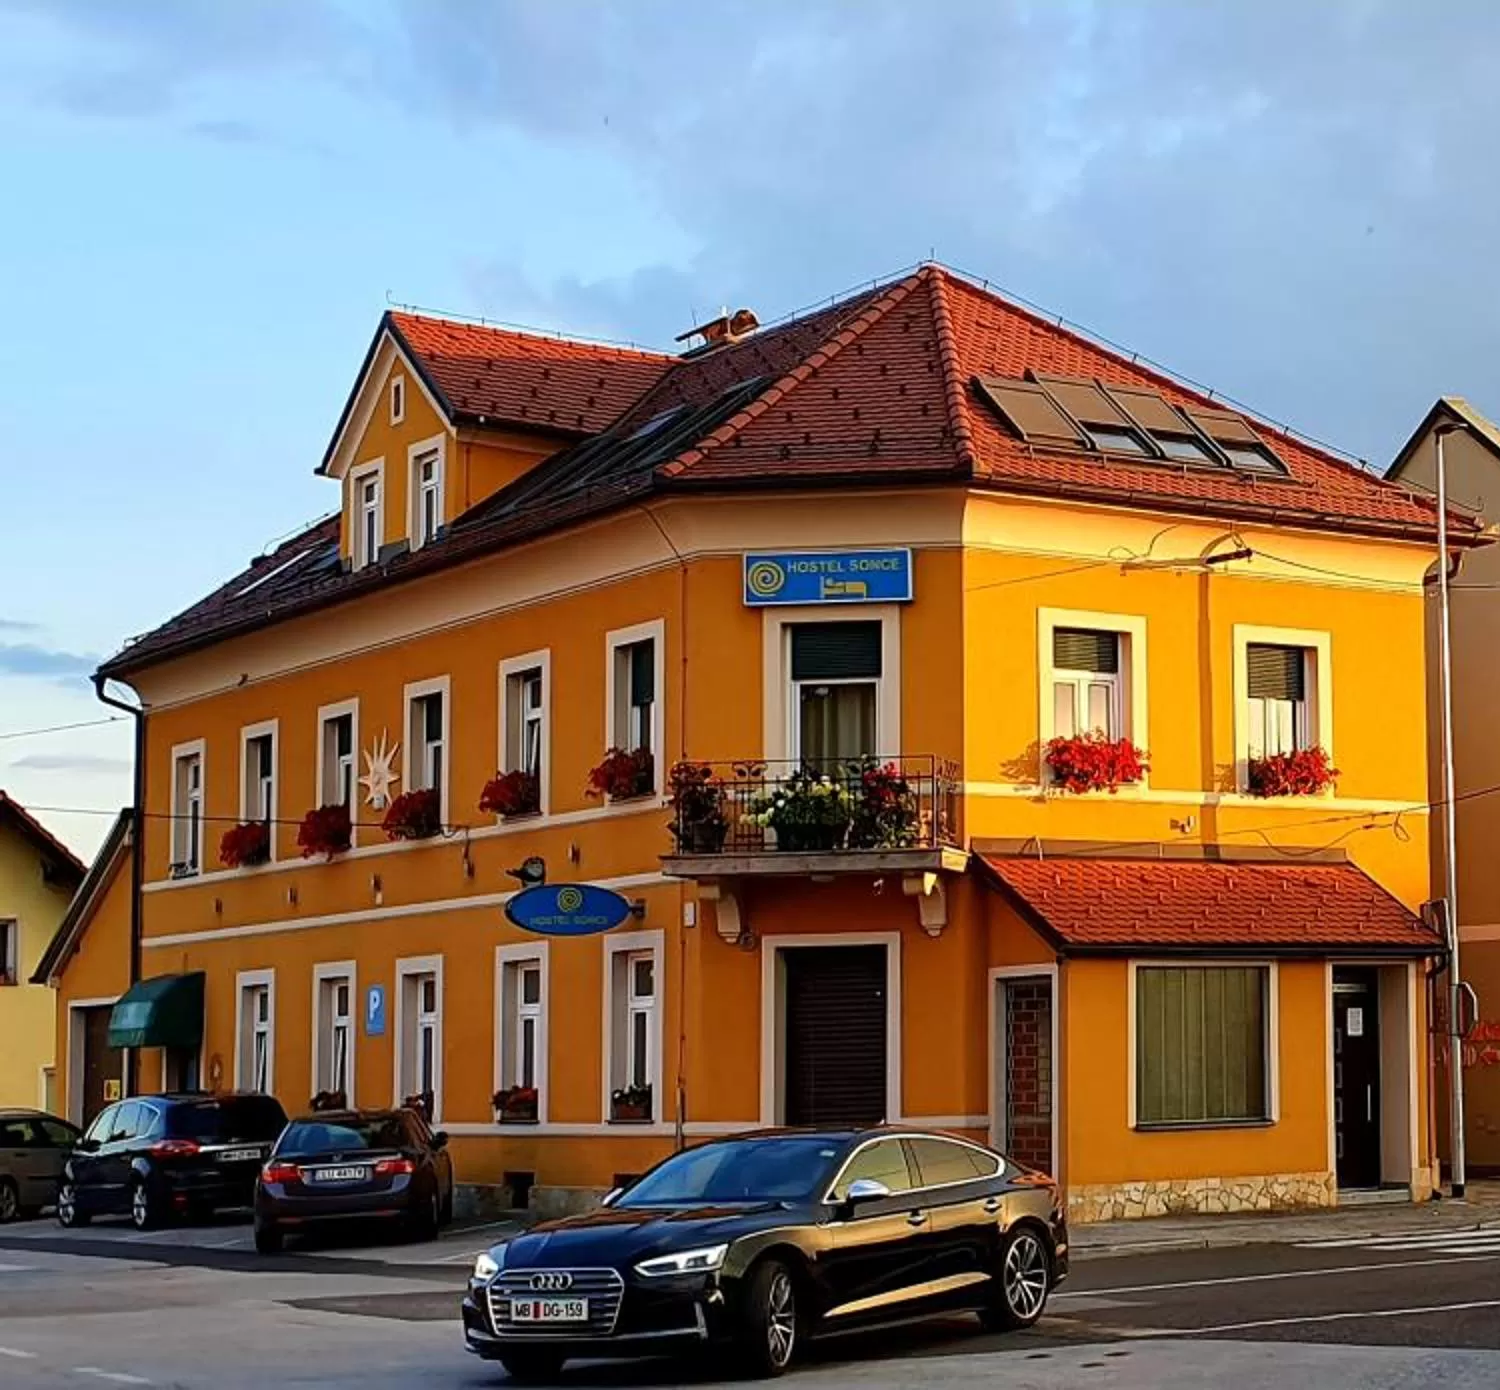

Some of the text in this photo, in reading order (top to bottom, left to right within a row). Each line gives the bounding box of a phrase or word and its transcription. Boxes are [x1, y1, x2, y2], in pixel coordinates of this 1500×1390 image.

[787, 557, 900, 573] HOSTEL SONCE
[369, 989, 380, 1021] P
[543, 1303, 583, 1318] DG-159
